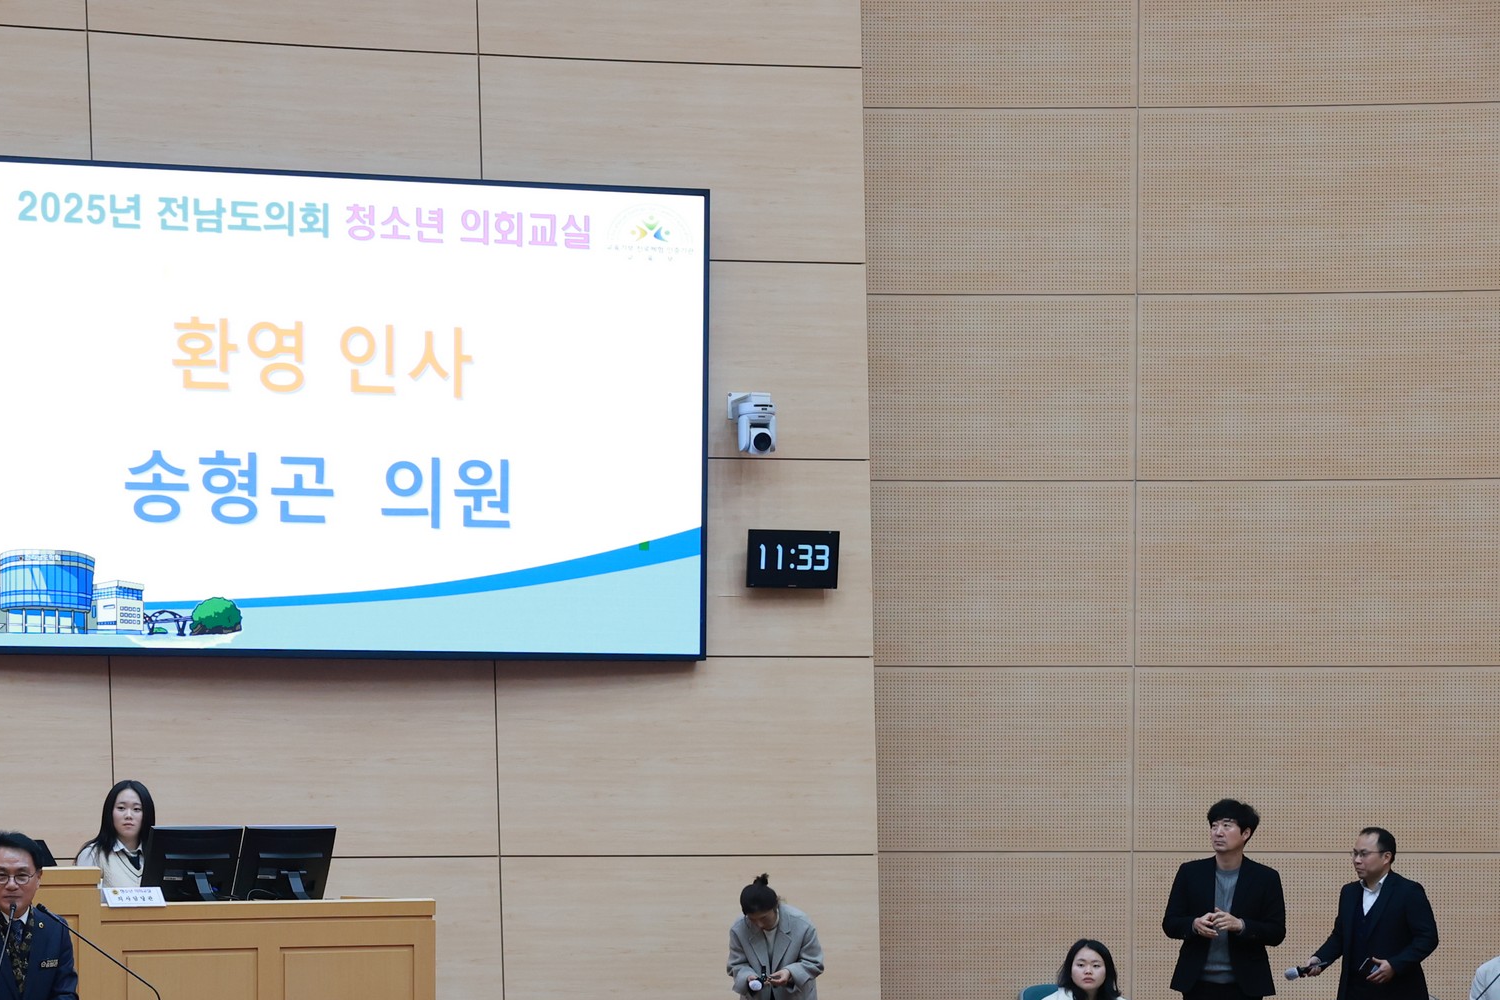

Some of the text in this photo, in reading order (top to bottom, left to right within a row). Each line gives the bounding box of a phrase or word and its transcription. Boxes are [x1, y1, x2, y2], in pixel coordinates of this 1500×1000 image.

[17, 190, 141, 229] 2025년
[157, 196, 330, 238] 전남도의회
[346, 203, 444, 243] 청소년
[460, 209, 591, 249] 의회교실
[171, 316, 474, 400] 환영 인사
[123, 449, 513, 529] 송형곤 의원
[759, 543, 830, 571] 11:33
